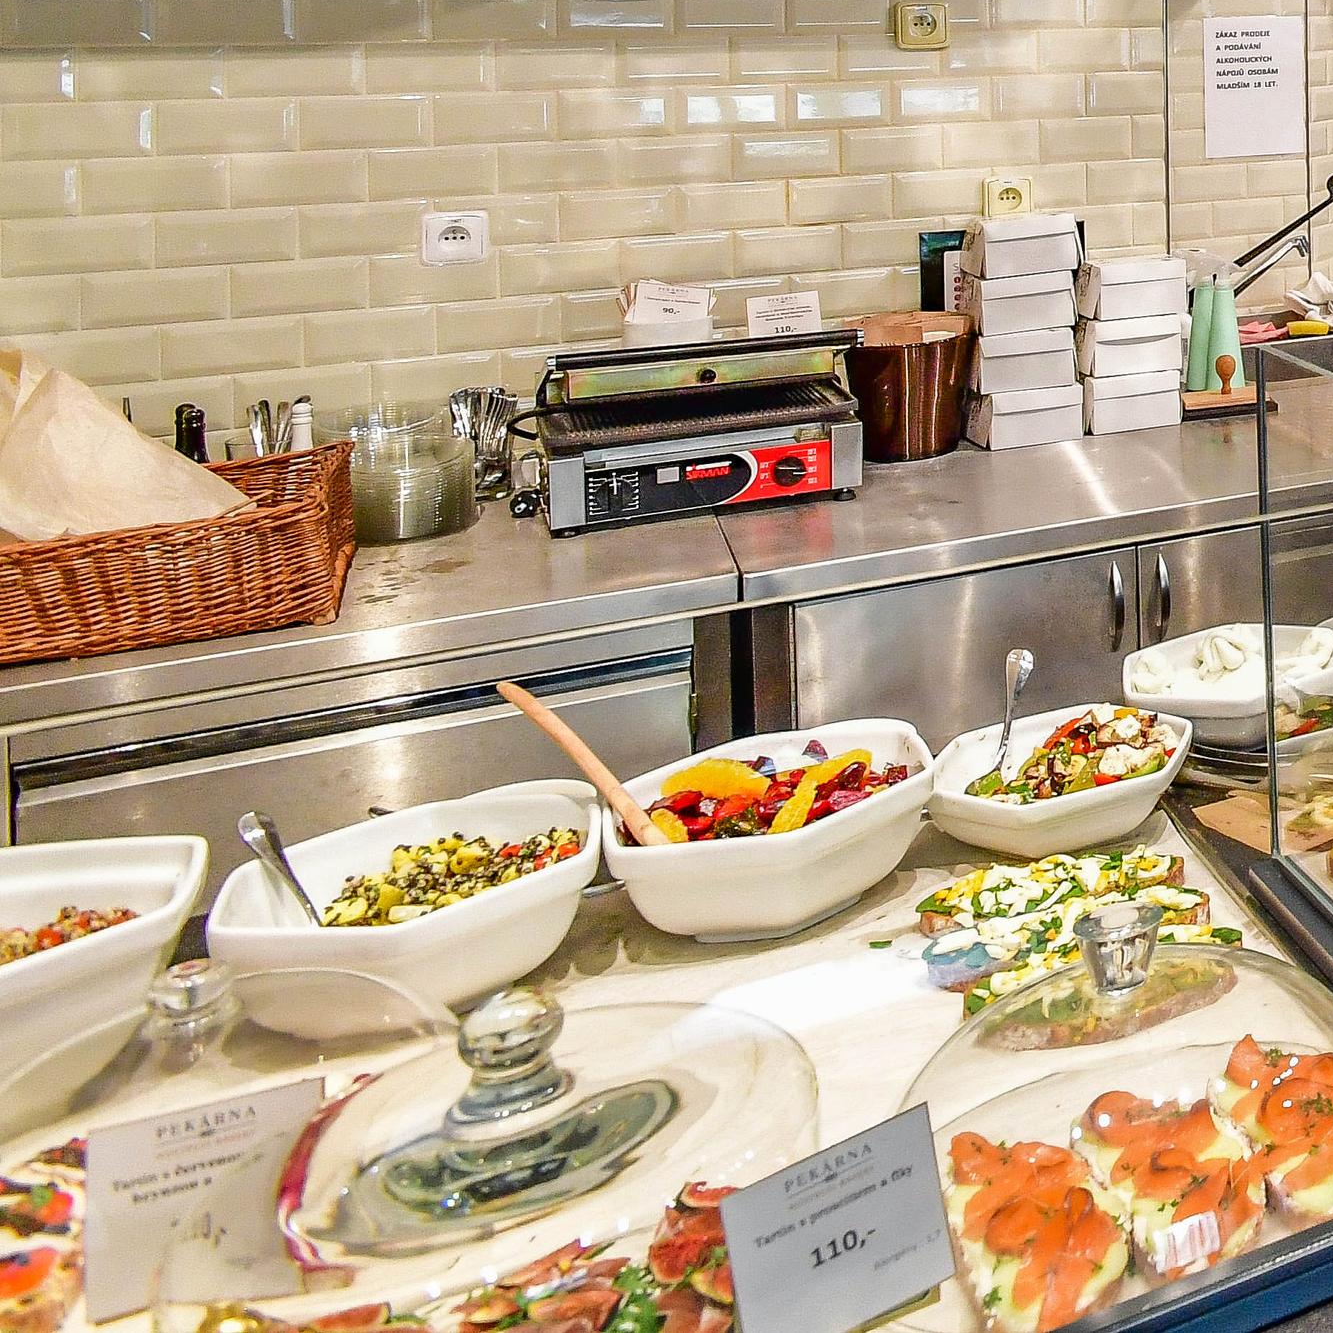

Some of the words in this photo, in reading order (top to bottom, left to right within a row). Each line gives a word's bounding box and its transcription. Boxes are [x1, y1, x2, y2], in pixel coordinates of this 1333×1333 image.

[1215, 29, 1237, 39] ZÁKAZ
[1240, 30, 1270, 38] PRODEJE
[1224, 42, 1262, 51] PODÁVÁNÍ
[1216, 55, 1273, 64] ALKOHOLICKÝCH
[1216, 68, 1244, 77] NÁPOJŮ
[1247, 68, 1279, 76] OSOBÁM
[1216, 81, 1250, 90] MLADŠÍM
[662, 307, 681, 315] 90,-
[775, 325, 798, 334] 110,-
[811, 1228, 876, 1269] 110,-
